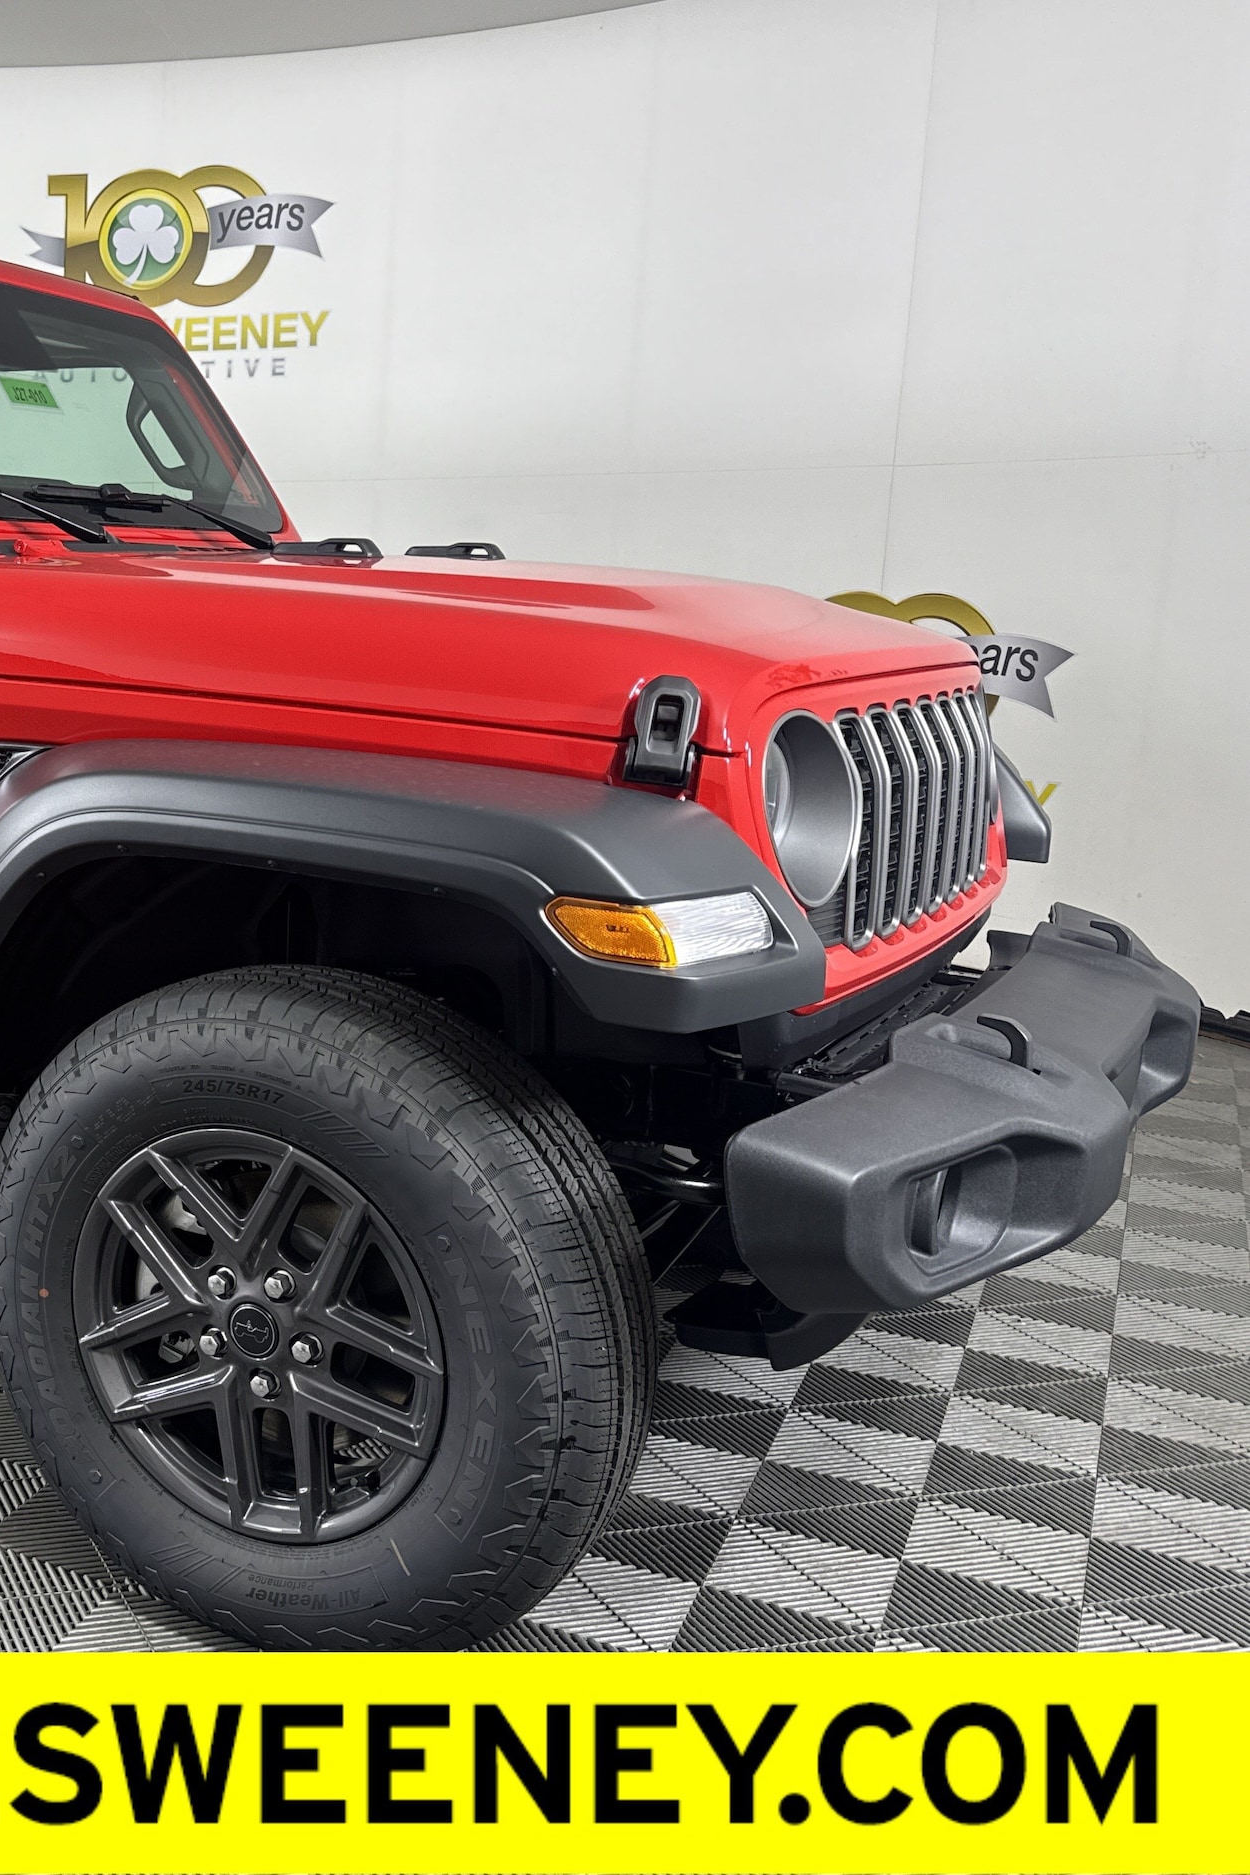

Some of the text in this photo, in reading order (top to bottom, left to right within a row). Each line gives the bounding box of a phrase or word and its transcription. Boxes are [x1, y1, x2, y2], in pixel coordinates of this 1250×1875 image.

[216, 200, 305, 243] years
[172, 310, 330, 350] EENEY
[969, 644, 1039, 682] ars
[182, 1079, 285, 1104] 245/75R17
[19, 1264, 95, 1463] ROADIAN
[443, 1256, 498, 1512] NEXEN
[245, 1587, 362, 1610] All-Weather
[247, 1573, 315, 1592] Performance
